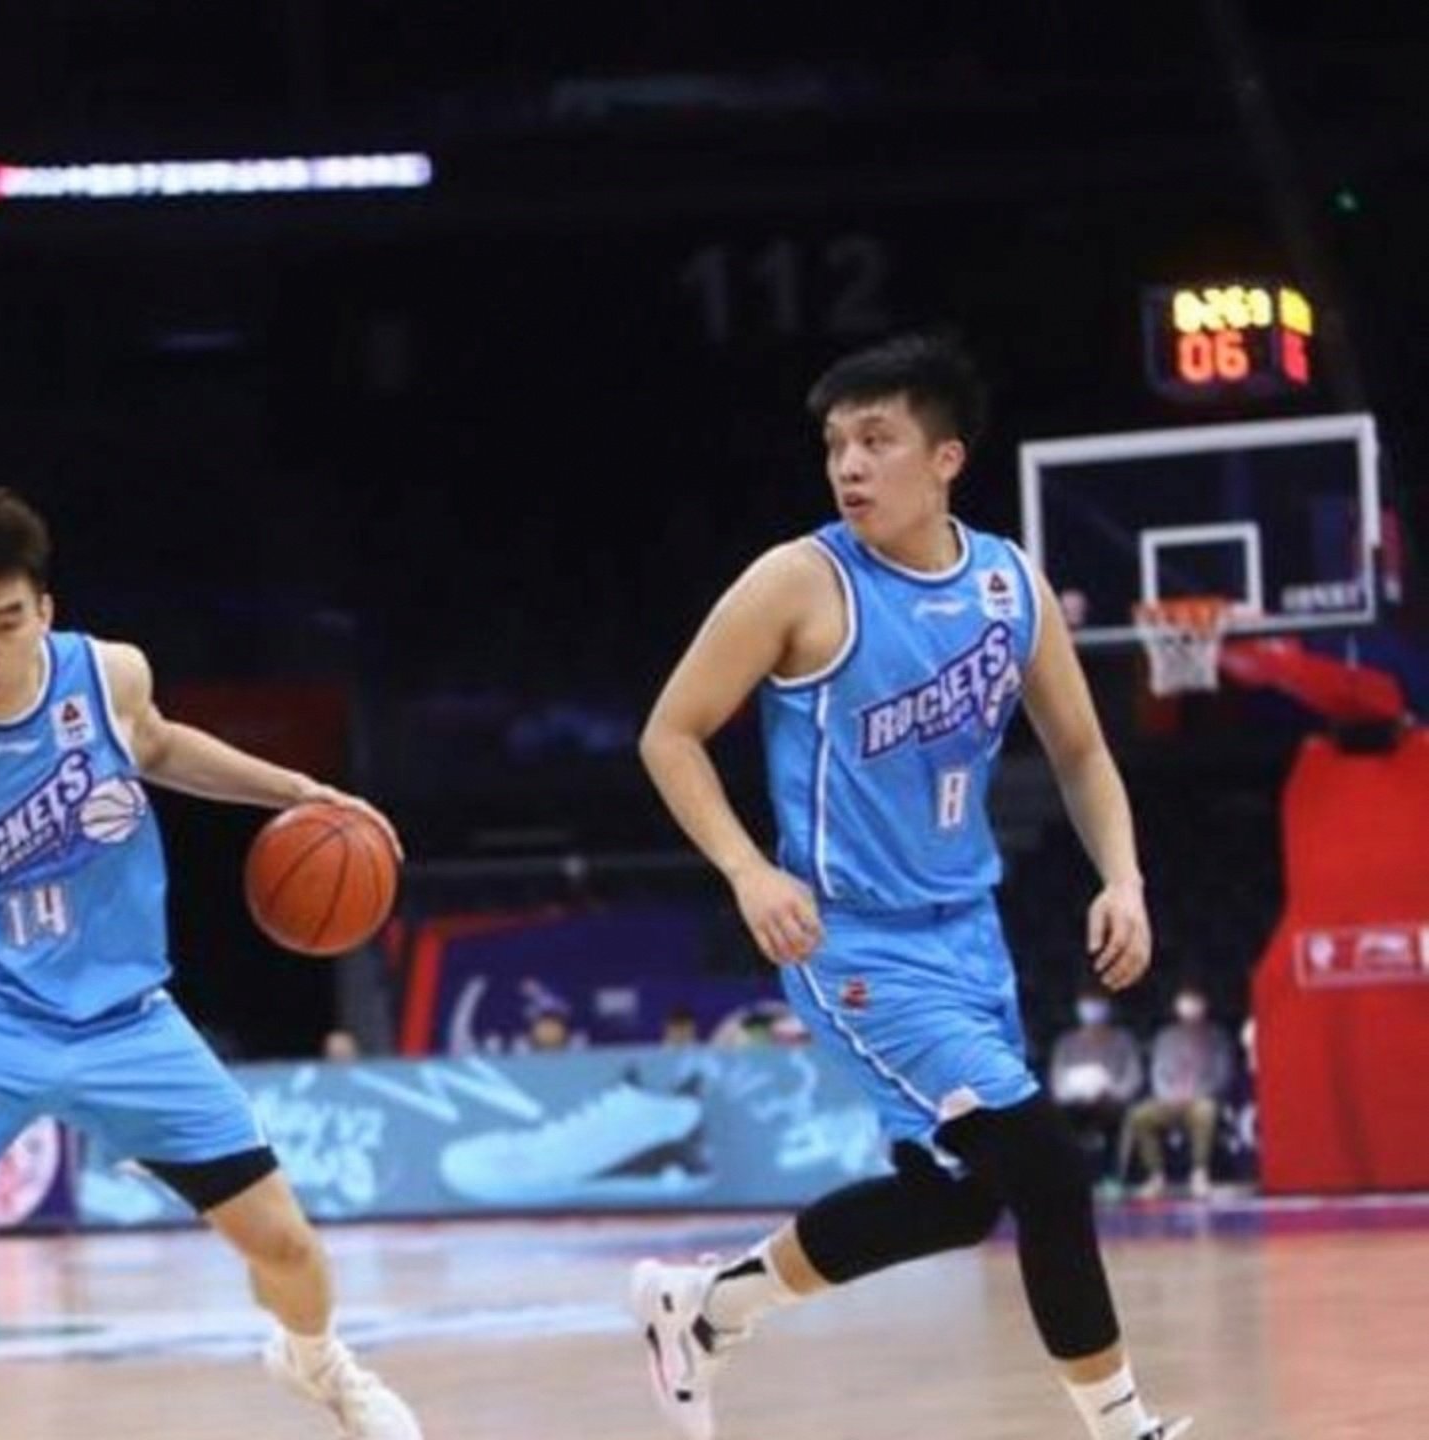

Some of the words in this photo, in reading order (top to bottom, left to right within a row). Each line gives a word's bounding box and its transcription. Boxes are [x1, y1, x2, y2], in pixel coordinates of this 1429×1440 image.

[682, 234, 887, 343] 112
[1179, 332, 1249, 382] 06
[937, 770, 969, 829] 8
[7, 884, 68, 946] 14
